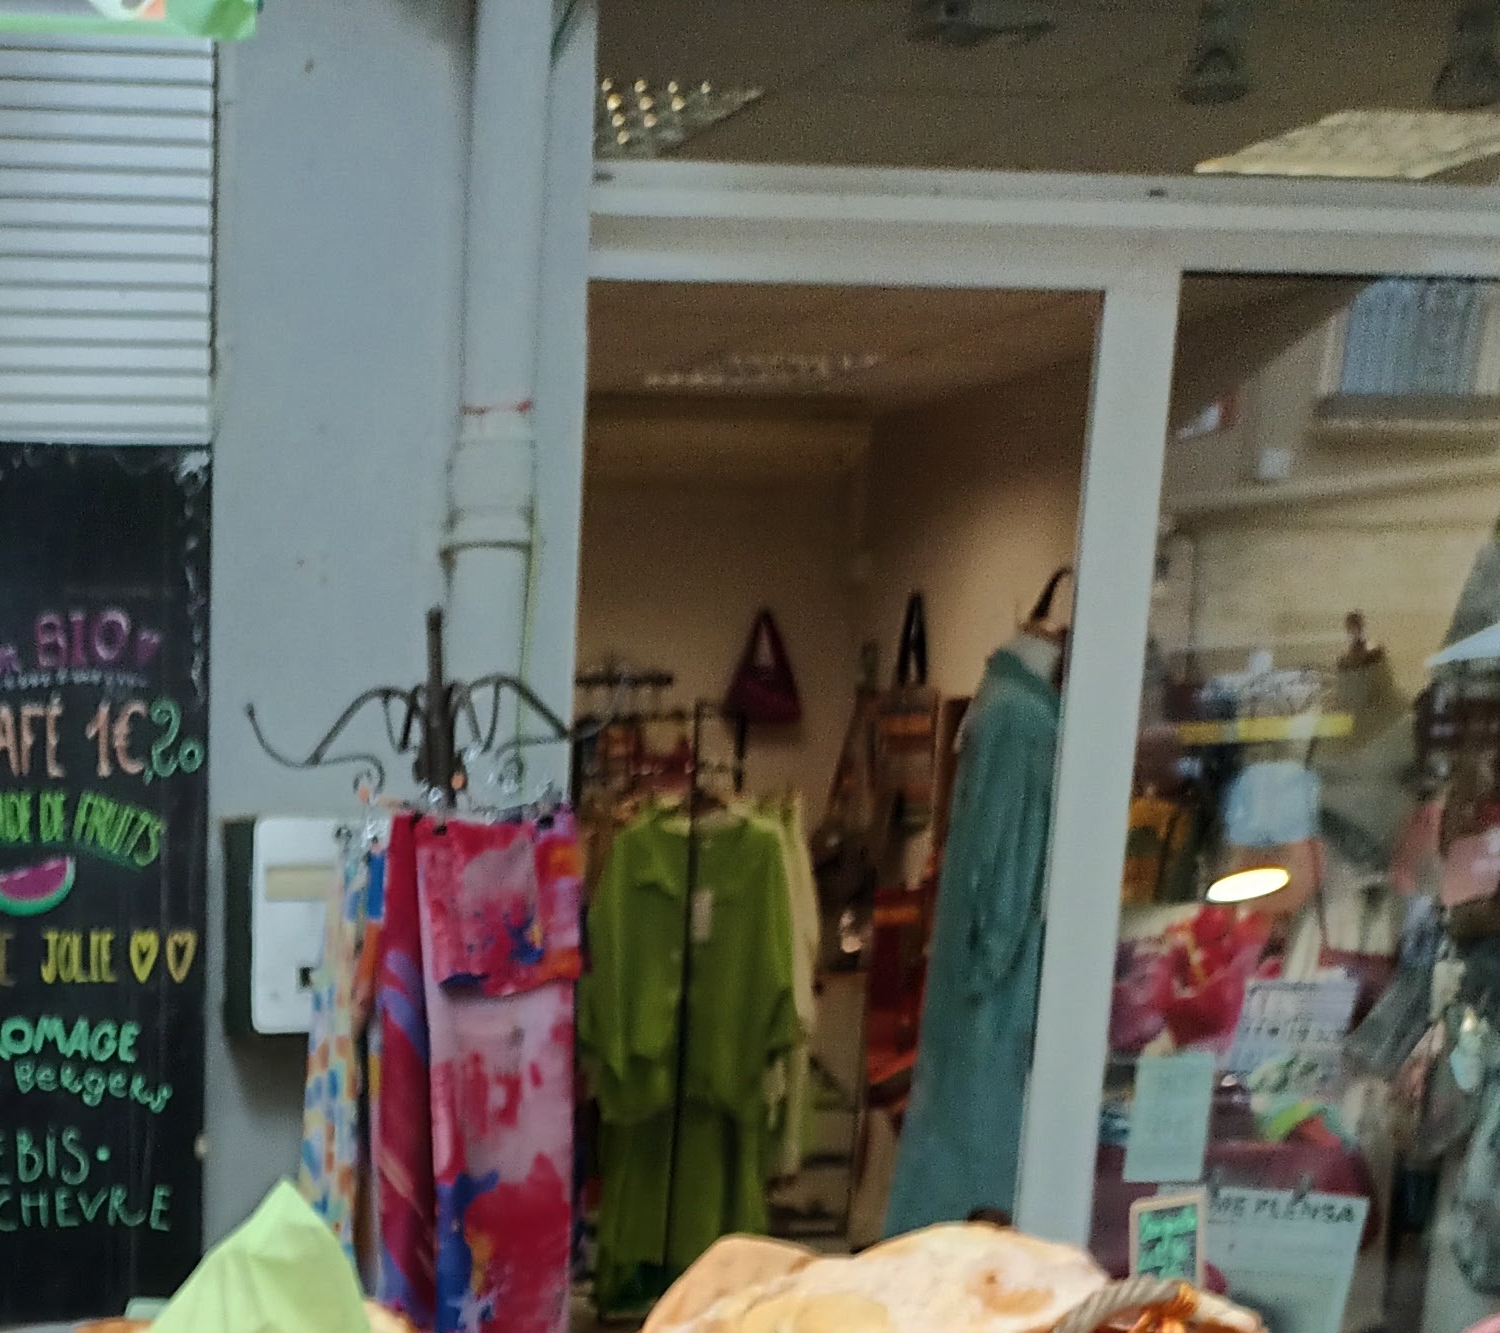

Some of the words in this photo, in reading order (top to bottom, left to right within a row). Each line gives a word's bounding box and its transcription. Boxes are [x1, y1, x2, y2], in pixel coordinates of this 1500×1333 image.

[35, 606, 131, 667] BIO
[72, 791, 163, 867] FRUITS
[41, 928, 117, 984] JOLIE
